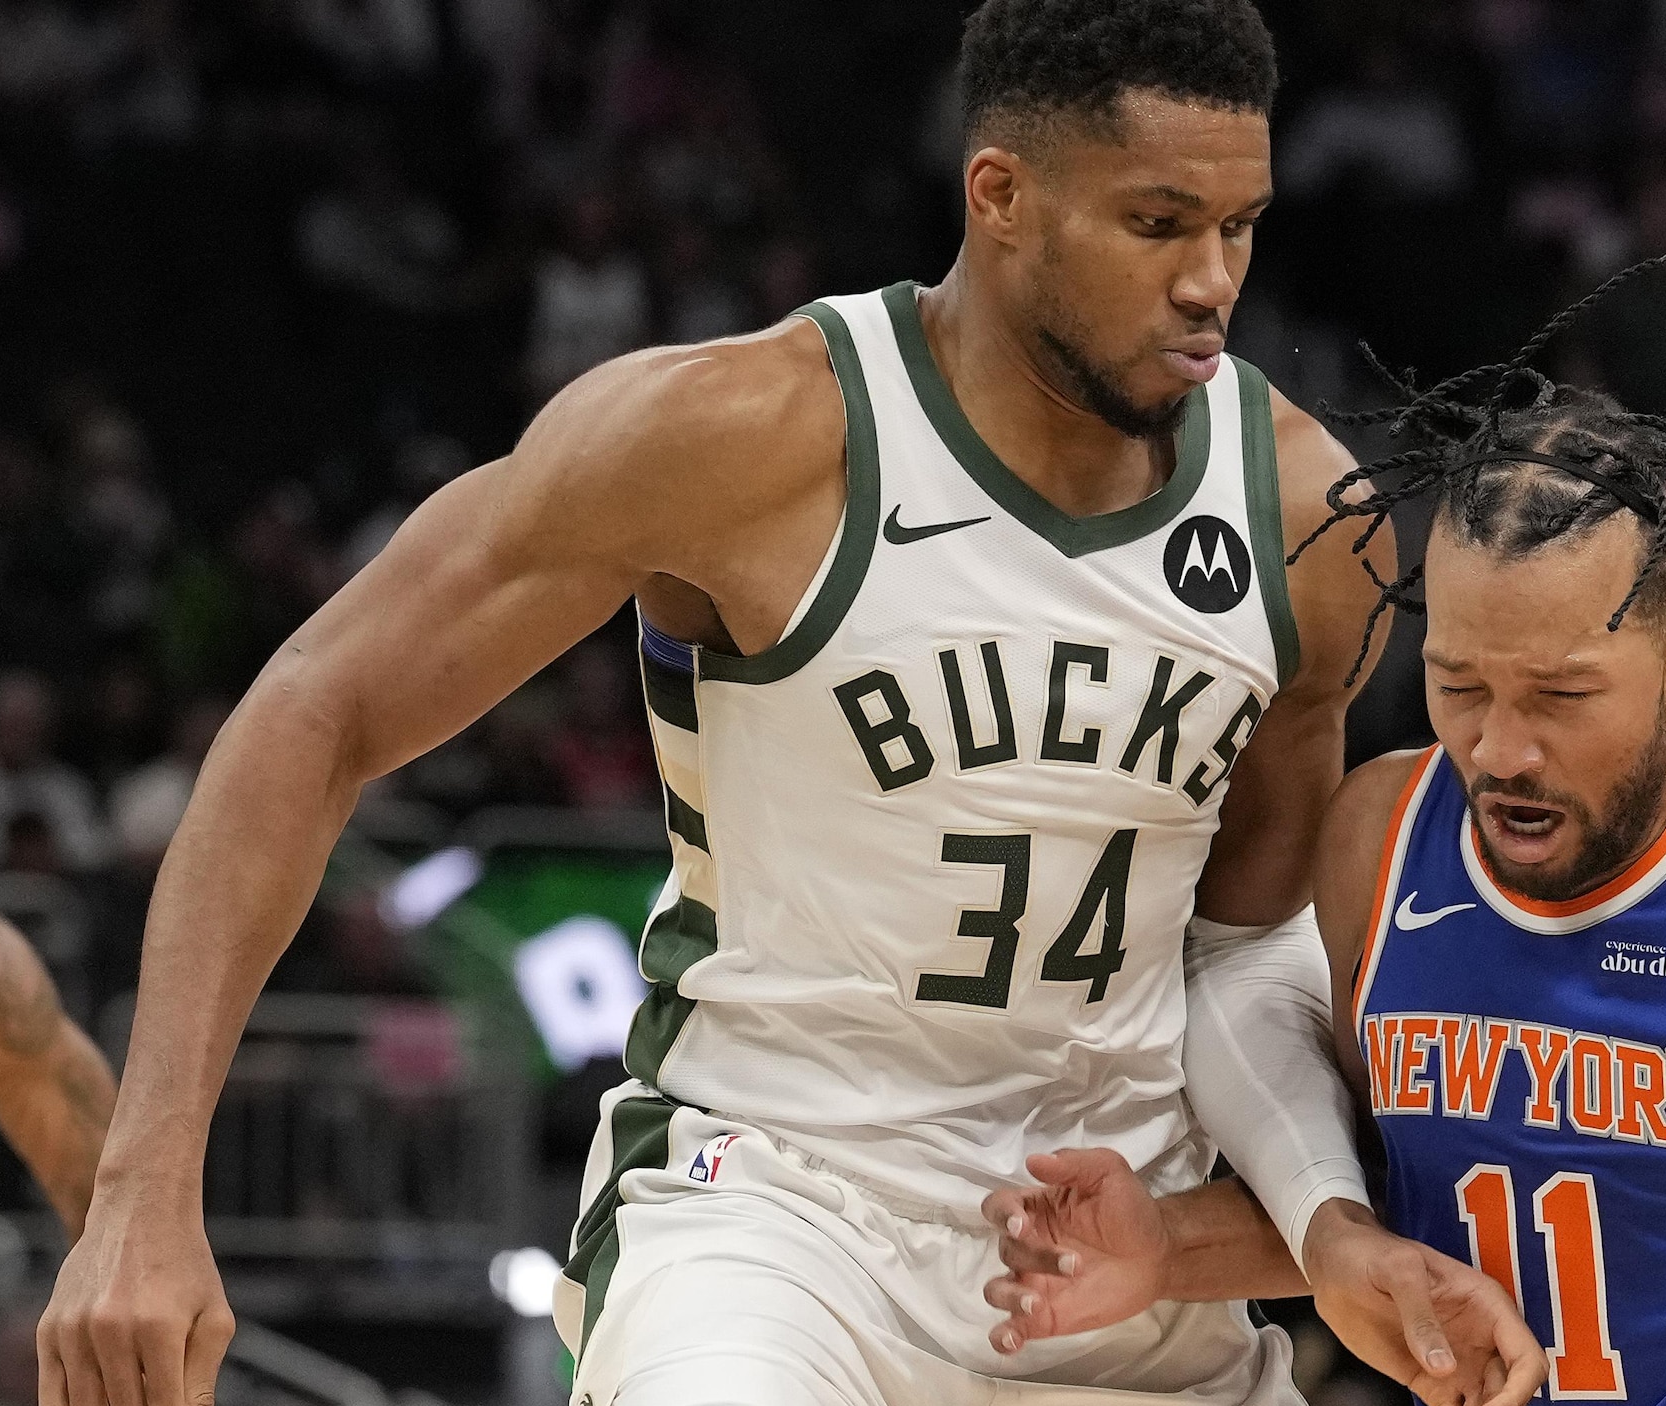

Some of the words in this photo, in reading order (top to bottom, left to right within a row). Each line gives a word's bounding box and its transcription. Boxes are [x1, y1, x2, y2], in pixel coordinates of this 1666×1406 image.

[830, 639, 1265, 809] BUCKS
[913, 827, 1139, 1011] 34
[1600, 951, 1646, 975] abu
[1605, 939, 1666, 954] experience
[1364, 1011, 1514, 1121] NEW
[1454, 1162, 1628, 1402] 11
